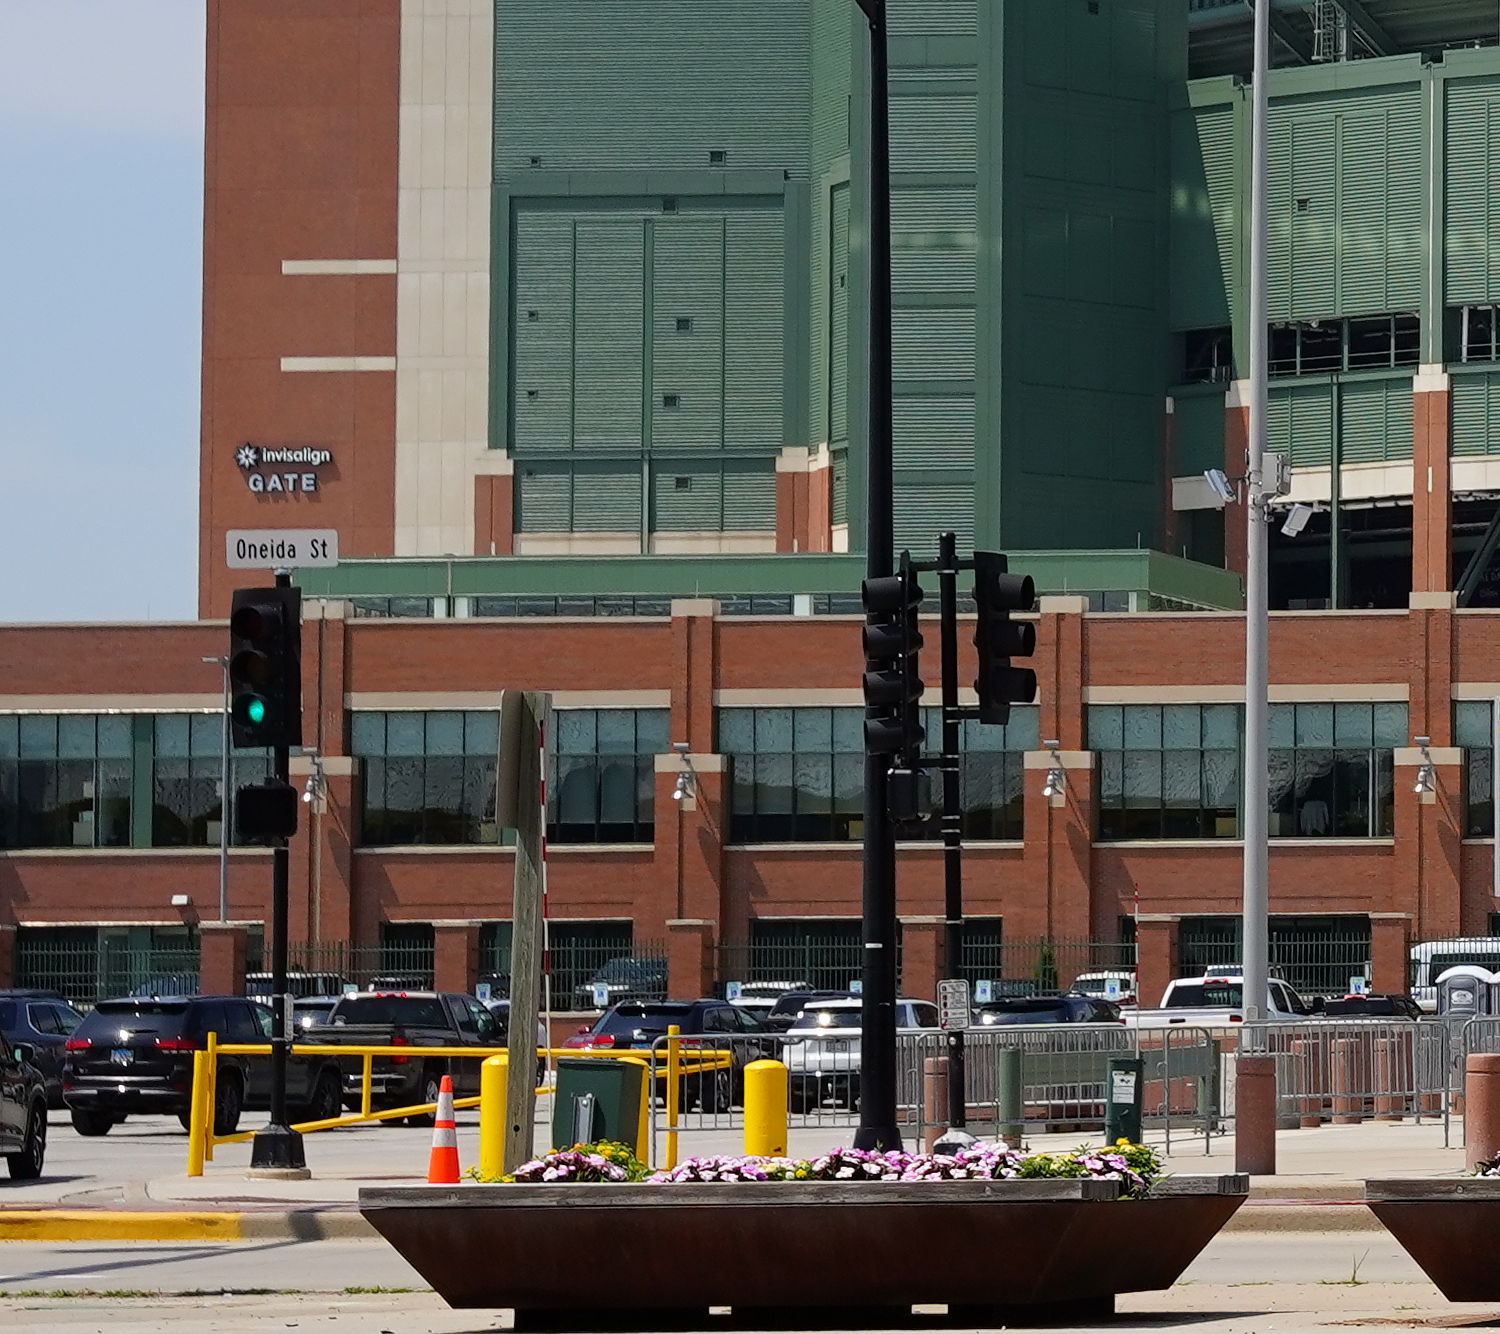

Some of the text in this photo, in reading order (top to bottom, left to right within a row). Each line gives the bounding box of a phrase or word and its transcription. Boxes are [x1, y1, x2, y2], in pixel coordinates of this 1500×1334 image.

[262, 447, 331, 465] invisalign
[248, 473, 317, 492] GATE
[236, 538, 328, 559] Oneida St
